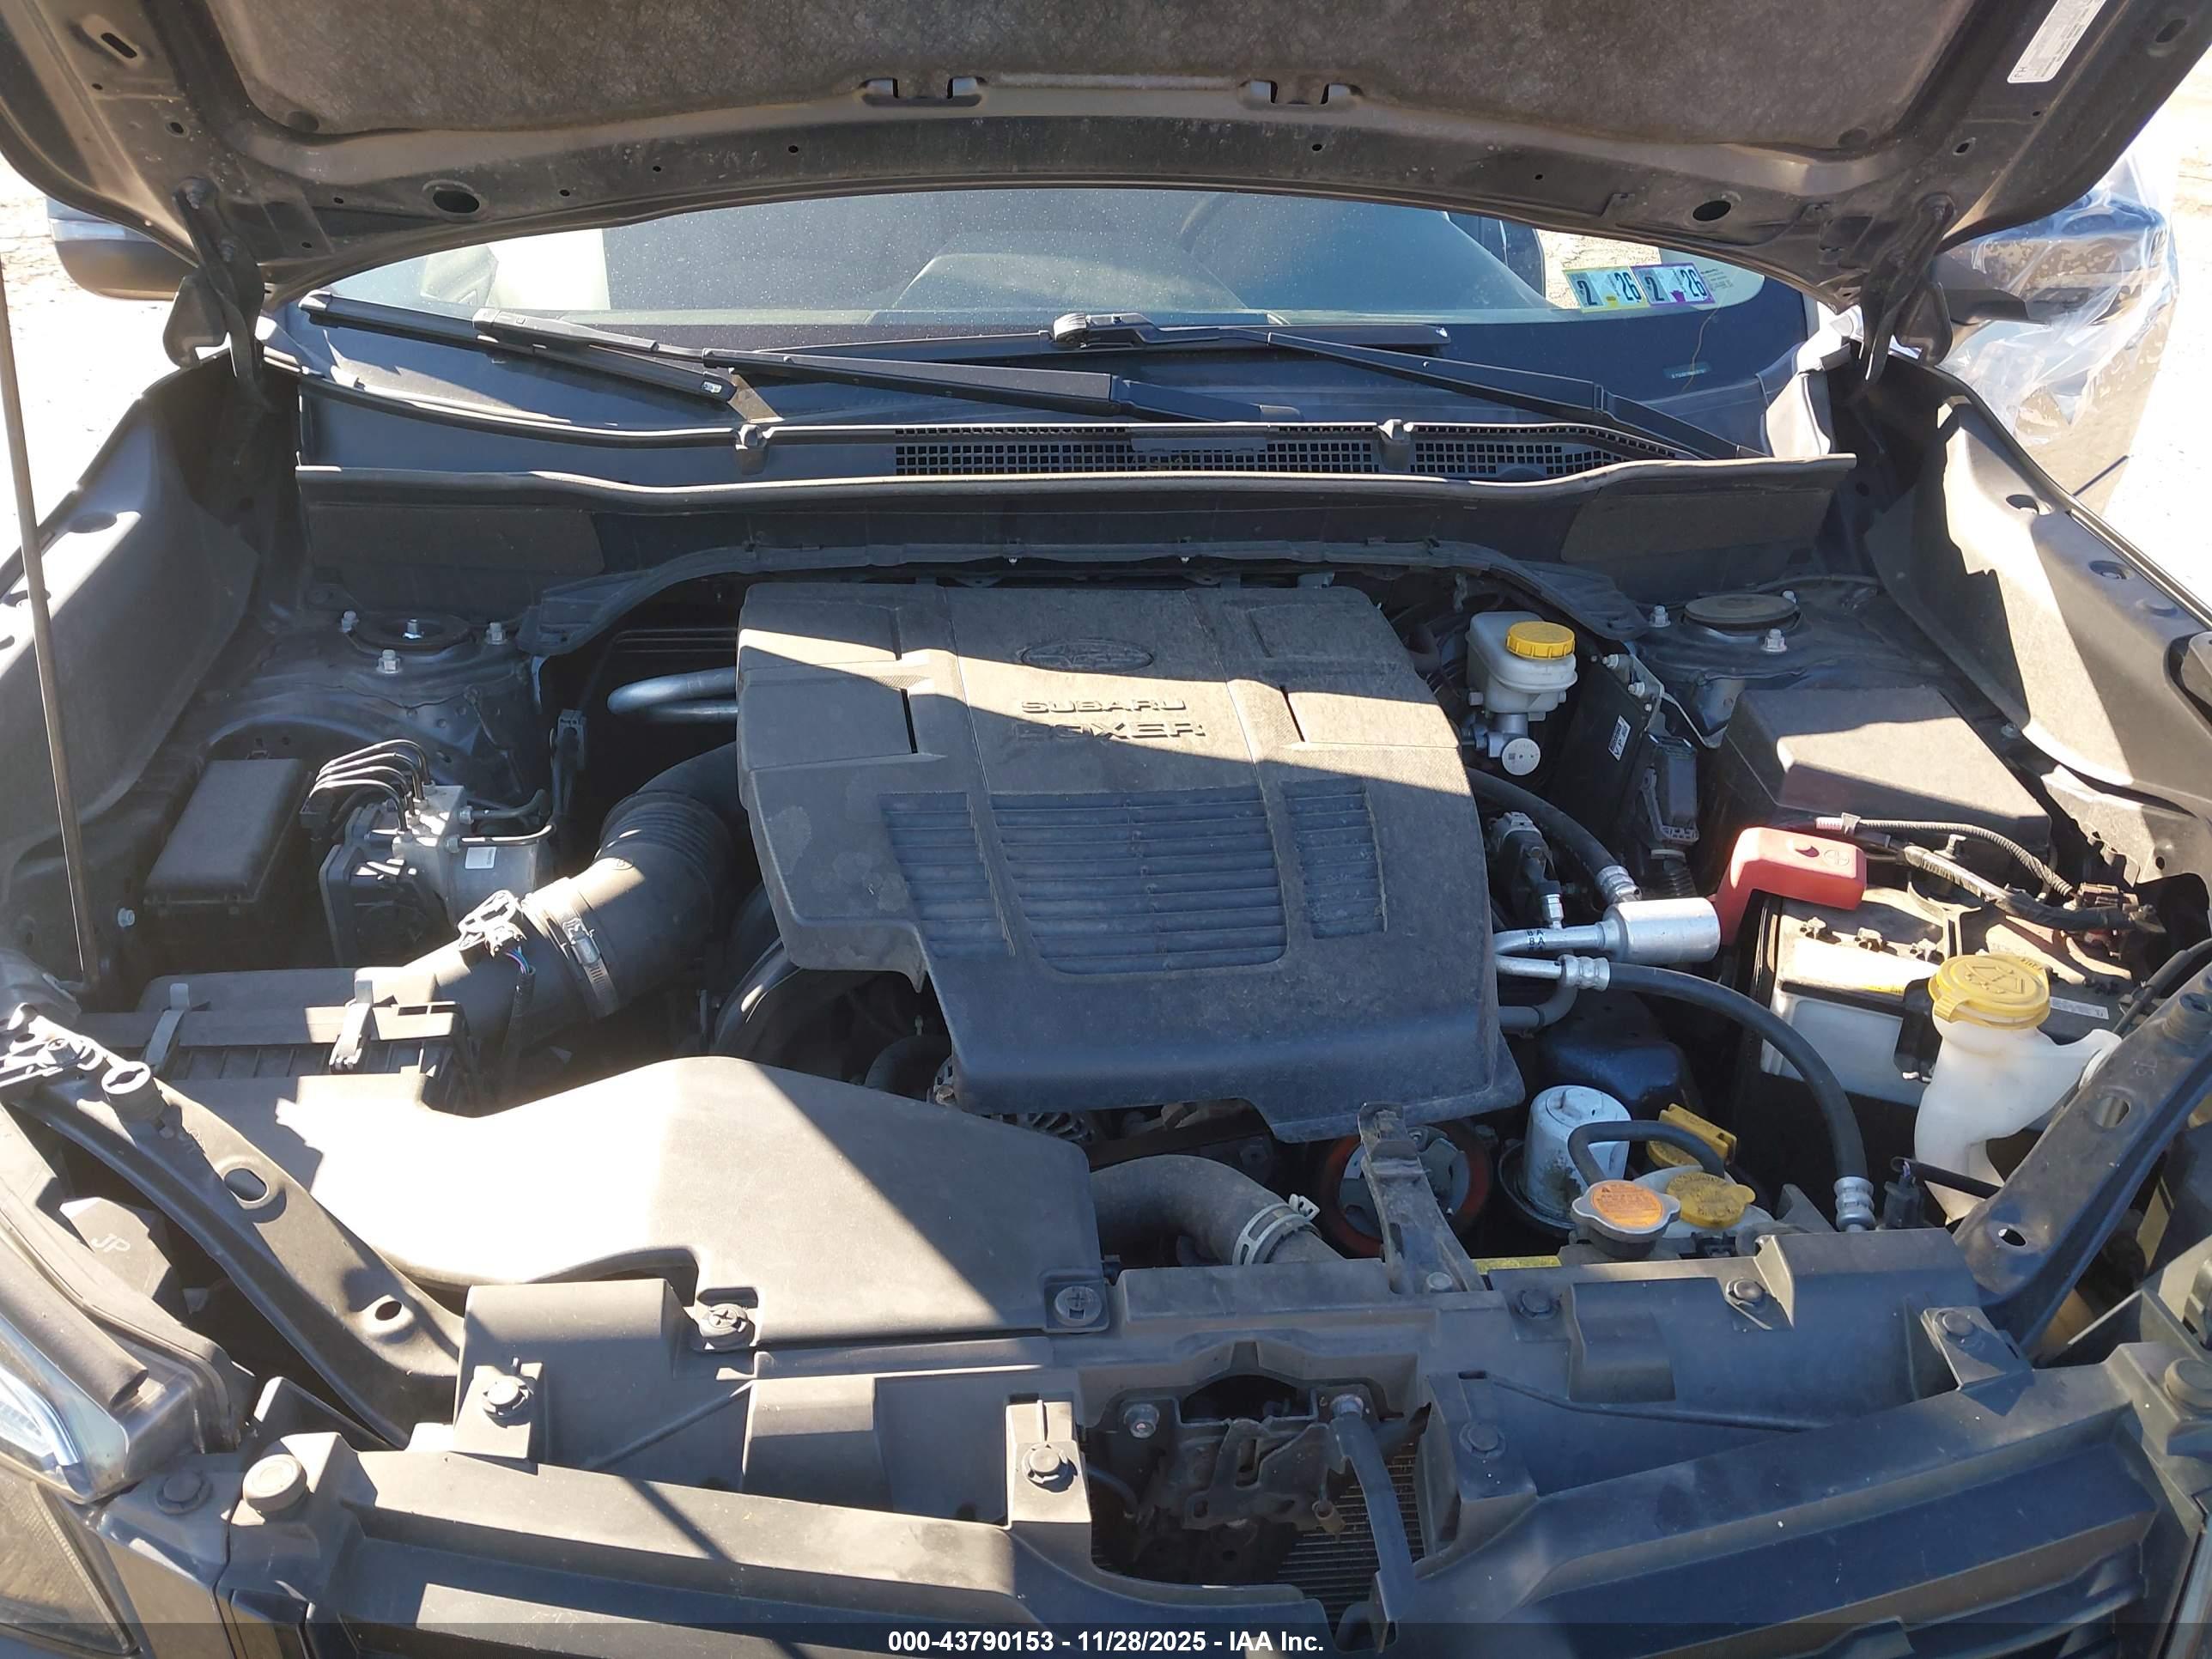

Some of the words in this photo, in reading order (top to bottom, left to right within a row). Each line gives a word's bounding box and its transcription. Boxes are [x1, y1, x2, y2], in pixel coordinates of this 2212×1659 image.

[1577, 280, 1598, 307] 2
[1613, 271, 1643, 301] 26
[1645, 276, 1665, 301] 2
[1680, 268, 1708, 297] 26
[1022, 700, 1187, 714] SUBARU
[1015, 722, 1206, 741] BOXER
[89, 1232, 131, 1253] JP
